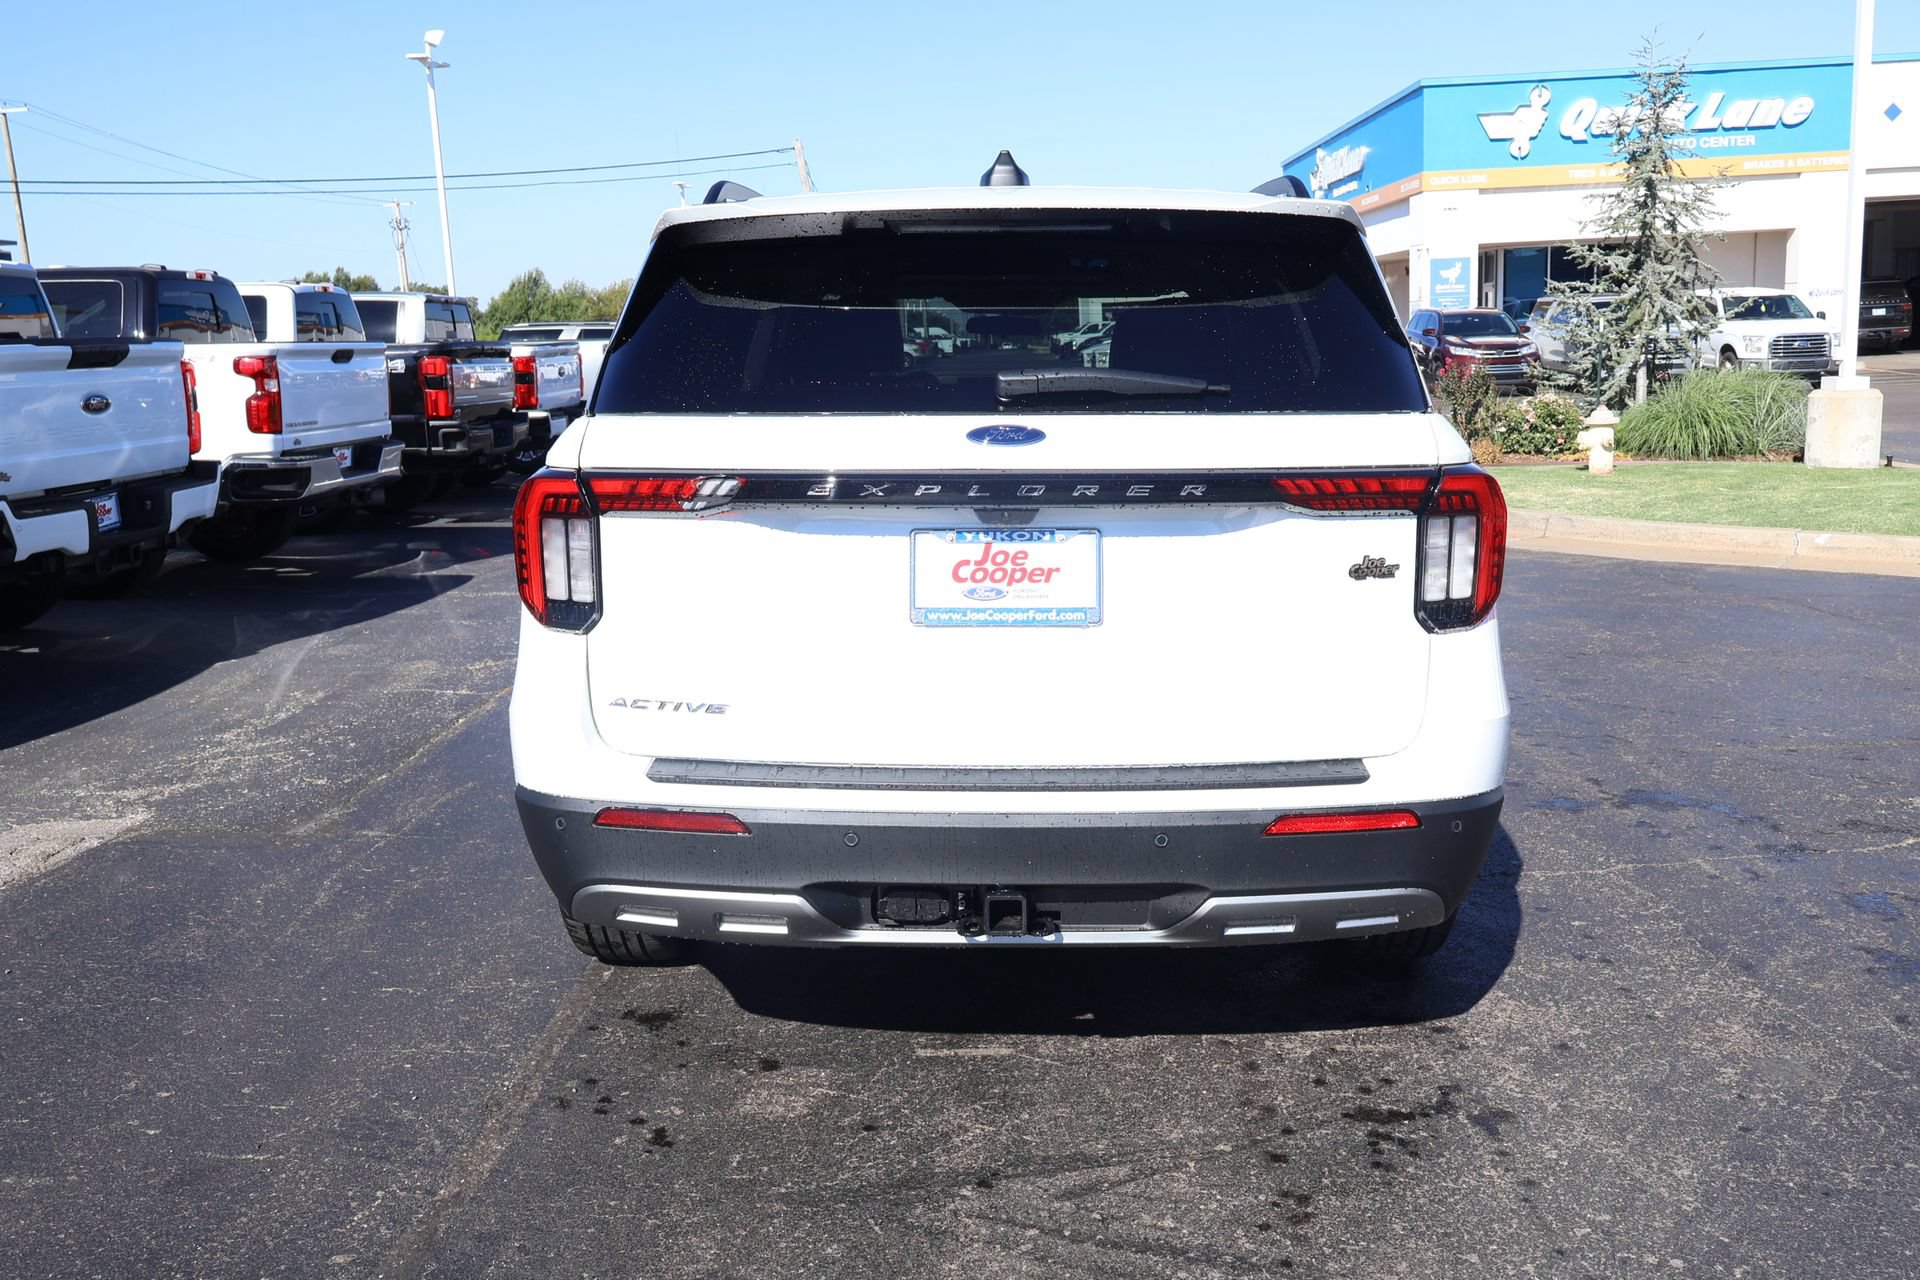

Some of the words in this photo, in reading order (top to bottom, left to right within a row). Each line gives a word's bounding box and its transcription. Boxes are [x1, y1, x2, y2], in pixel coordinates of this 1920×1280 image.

[1692, 91, 1815, 131] Lane
[1699, 134, 1756, 149] CENTER
[1743, 159, 1785, 170] BRAKES
[806, 484, 1208, 498] EXPLORER
[960, 530, 1051, 542] YUKON
[973, 542, 1029, 567] Joe
[1361, 555, 1386, 569] Joe
[951, 559, 1061, 587] Cooper
[1349, 563, 1400, 580] Cooper
[926, 608, 1086, 622] www.JoeCooperFord.com
[608, 697, 731, 715] ACTIVE
